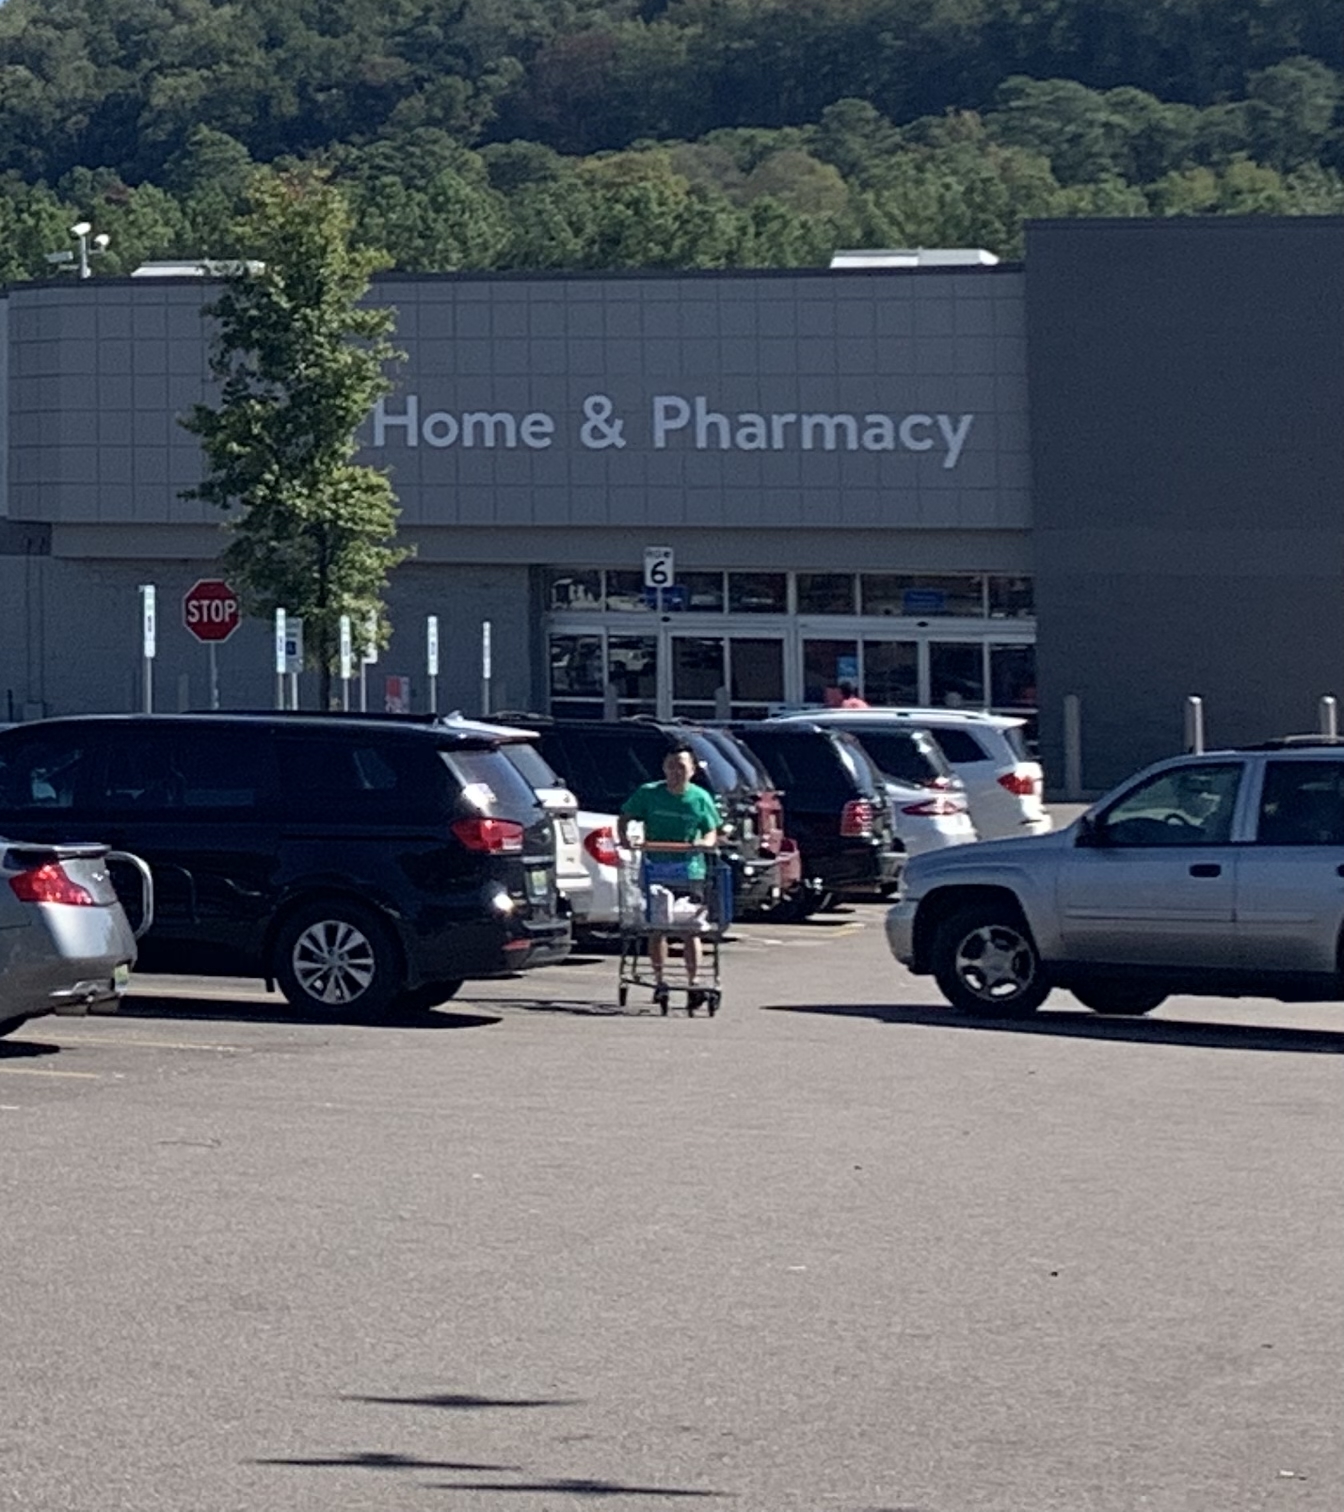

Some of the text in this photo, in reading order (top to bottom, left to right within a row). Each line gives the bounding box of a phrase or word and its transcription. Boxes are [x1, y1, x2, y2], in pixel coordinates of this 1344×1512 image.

[372, 394, 973, 468] Home & Pharmacy
[651, 560, 668, 584] 6
[187, 599, 237, 623] STOP
